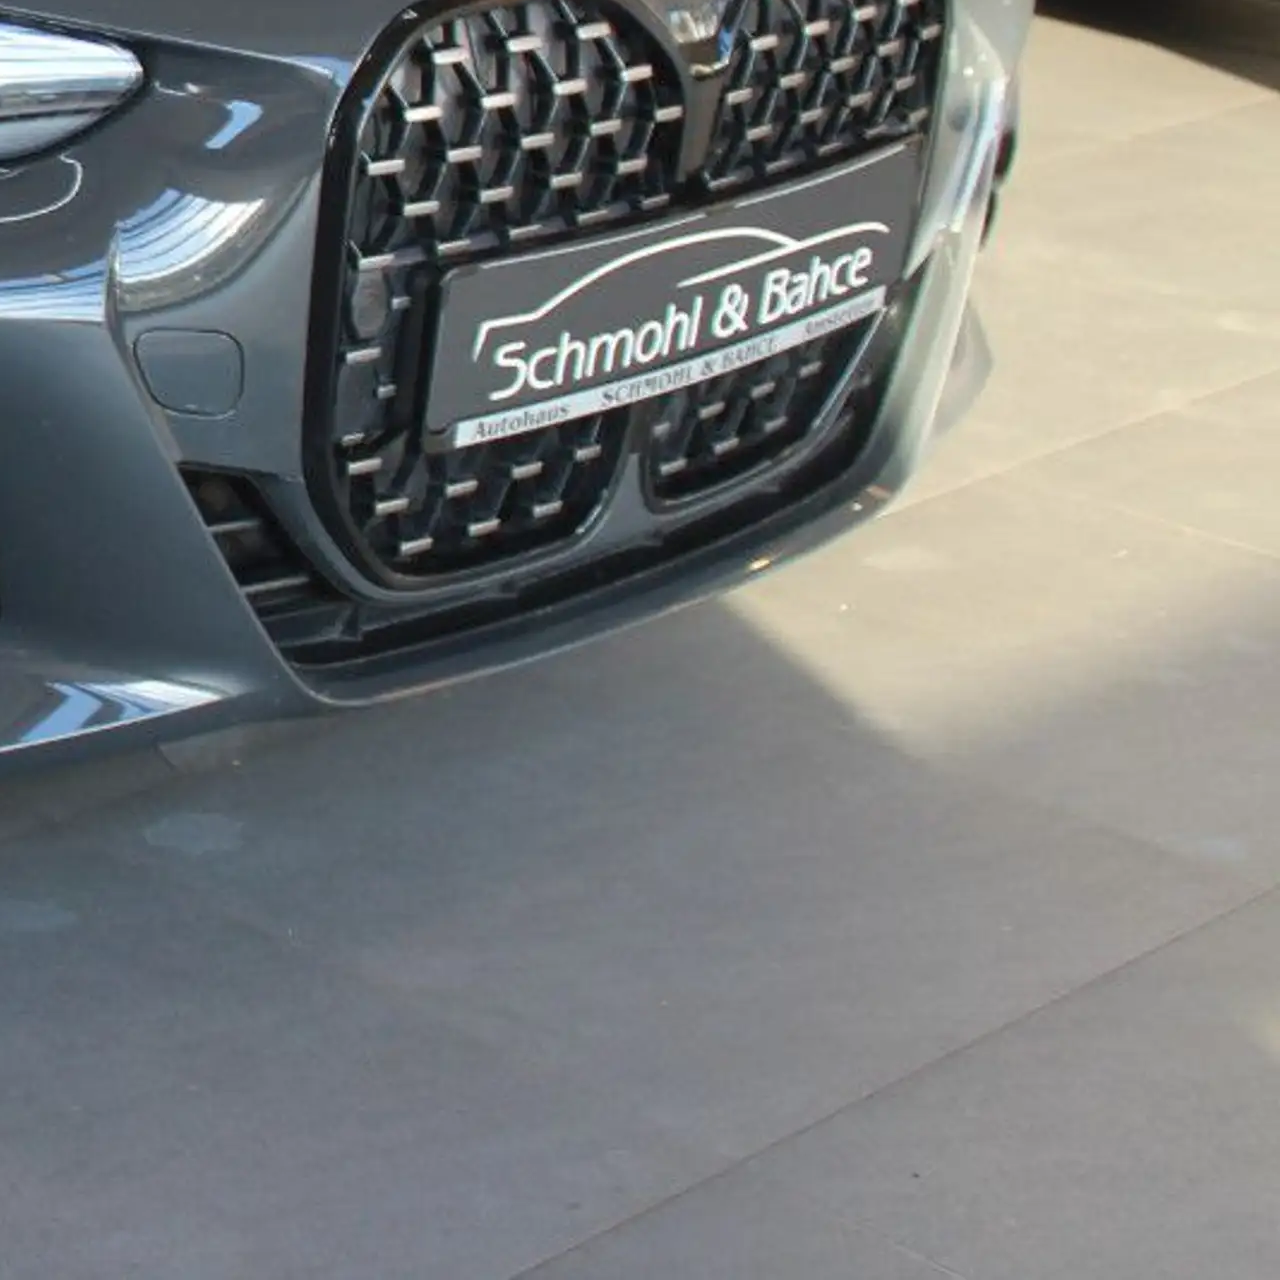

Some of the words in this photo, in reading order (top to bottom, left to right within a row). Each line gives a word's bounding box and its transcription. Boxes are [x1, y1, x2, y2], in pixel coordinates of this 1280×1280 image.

[490, 298, 700, 400] Schmohl
[713, 284, 748, 337] &
[758, 247, 872, 324] Bahce
[476, 404, 569, 438] Autohaus
[601, 366, 691, 405] SCHMOHL
